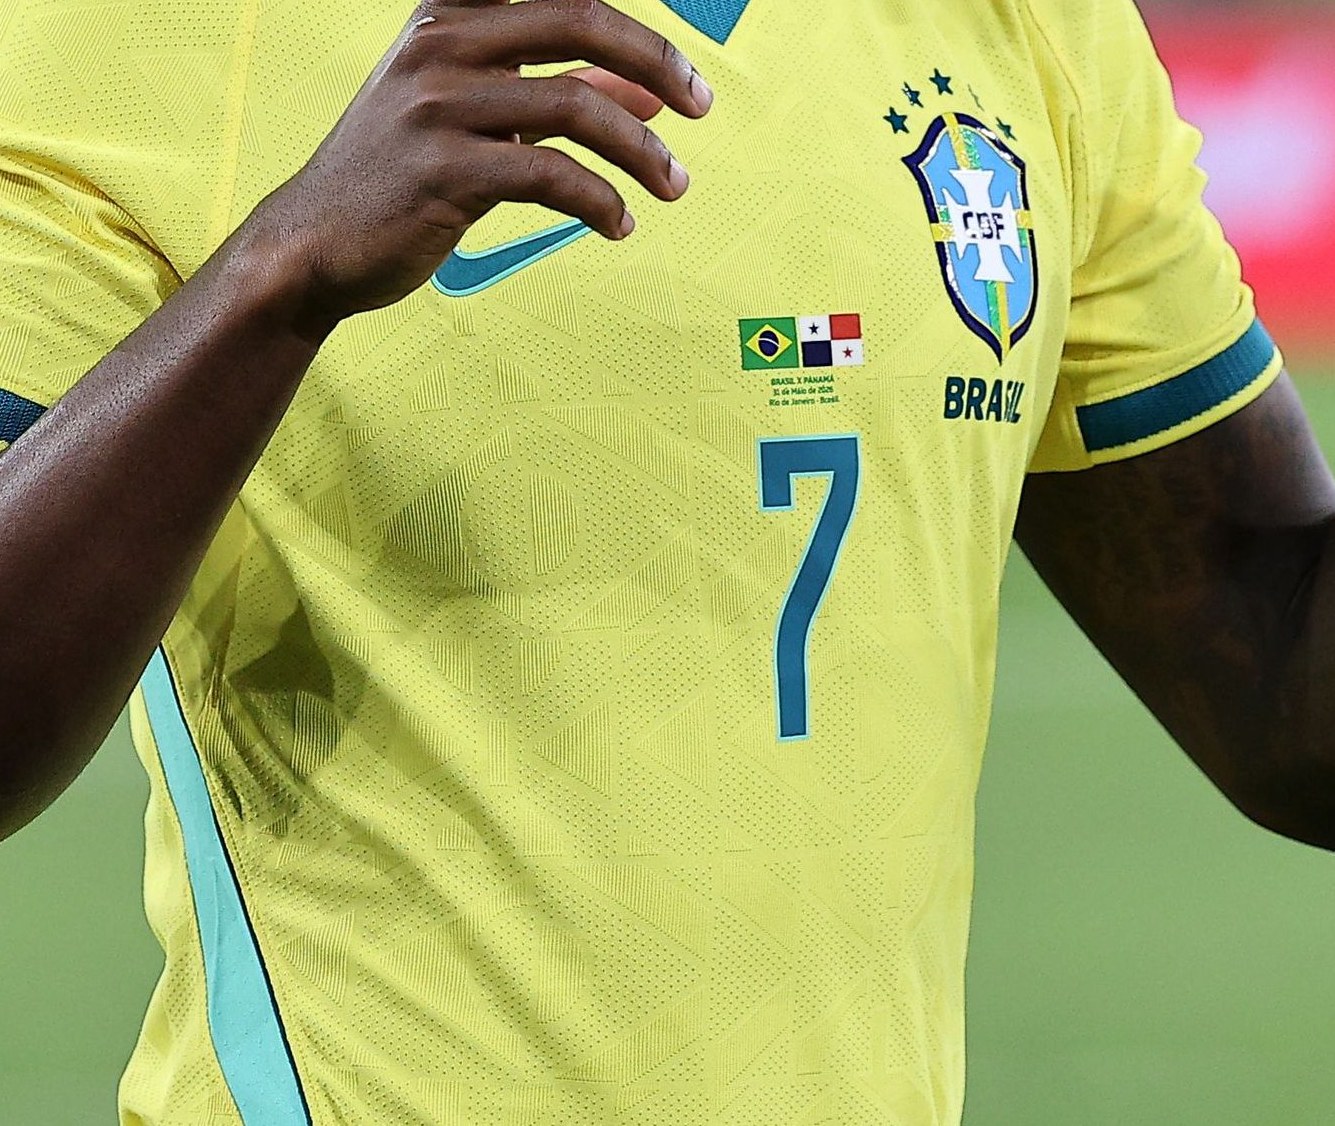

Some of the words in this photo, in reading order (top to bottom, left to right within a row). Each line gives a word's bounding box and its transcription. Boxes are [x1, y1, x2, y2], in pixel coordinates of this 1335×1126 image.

[962, 210, 1004, 240] CBF
[771, 377, 795, 385] BRASIL
[769, 398, 780, 406] Rio
[781, 397, 789, 405] de
[791, 397, 815, 405] Janeiro
[758, 434, 860, 740] 7
